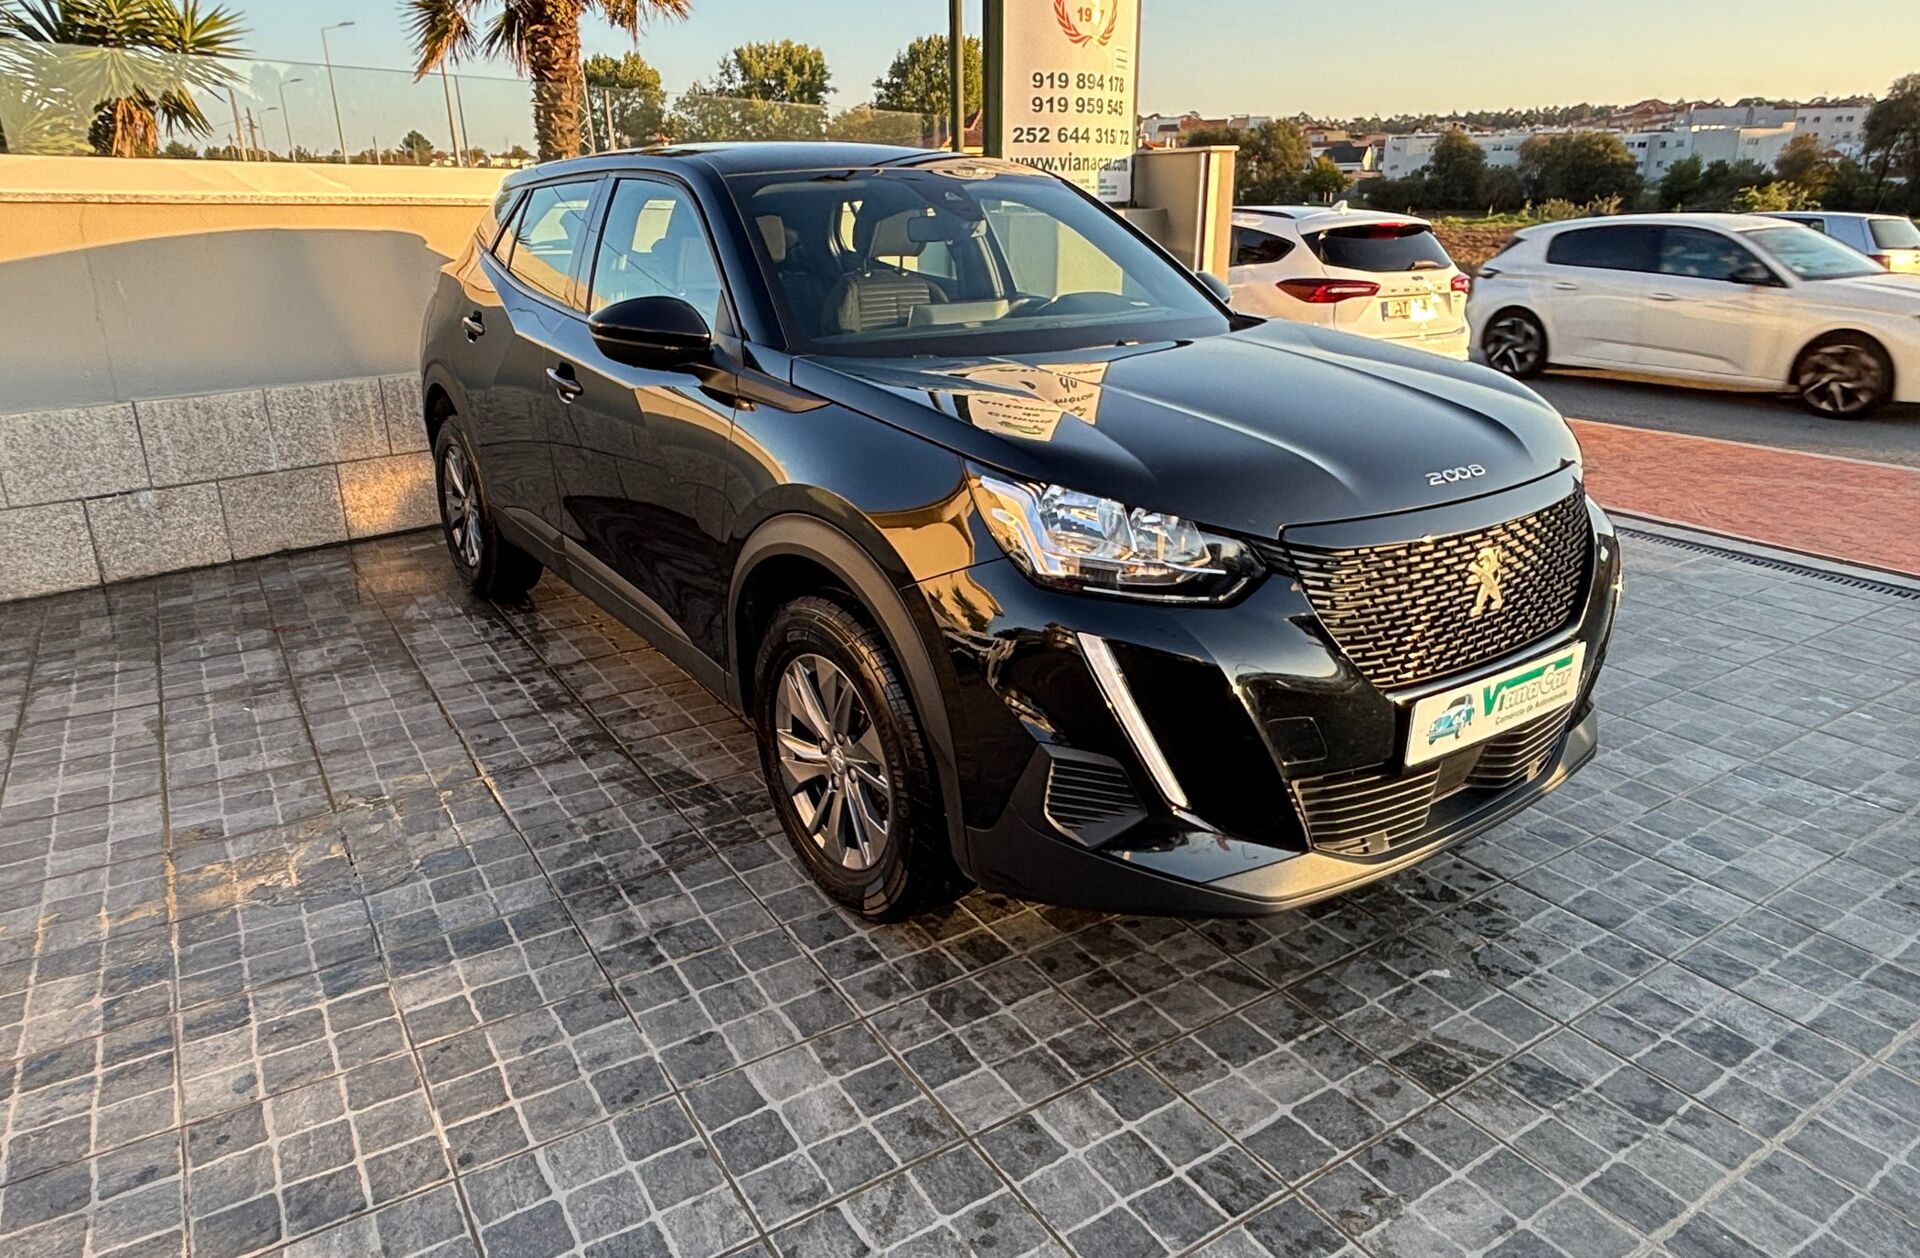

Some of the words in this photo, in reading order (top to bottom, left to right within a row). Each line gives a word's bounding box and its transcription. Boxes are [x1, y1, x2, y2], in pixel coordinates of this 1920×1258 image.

[1077, 6, 1105, 25] 197
[1032, 72, 1069, 89] 919
[1076, 73, 1104, 91] 894
[1108, 75, 1124, 93] 178
[1032, 97, 1068, 113] 919
[1075, 97, 1104, 114] 959
[1107, 99, 1123, 116] 545
[1012, 127, 1050, 143] 252
[1057, 127, 1090, 143] 644
[1424, 464, 1486, 486] 2008
